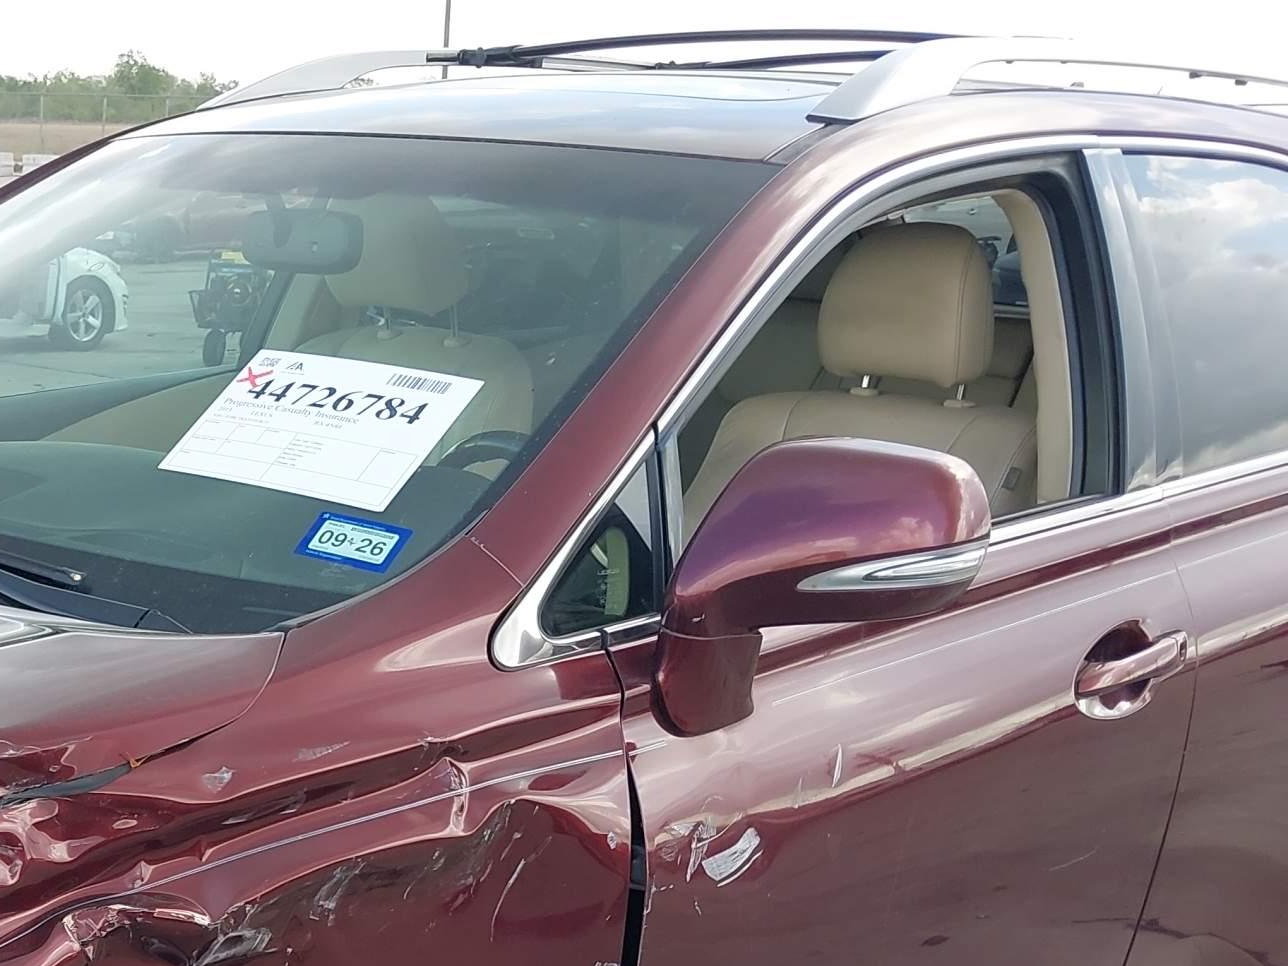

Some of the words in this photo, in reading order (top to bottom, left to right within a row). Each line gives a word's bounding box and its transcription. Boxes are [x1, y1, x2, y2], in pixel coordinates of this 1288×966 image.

[248, 379, 429, 424] 44726784
[274, 404, 312, 418] Casualty
[315, 410, 360, 425] Insurance
[318, 530, 348, 547] 09
[354, 538, 387, 556] 26
